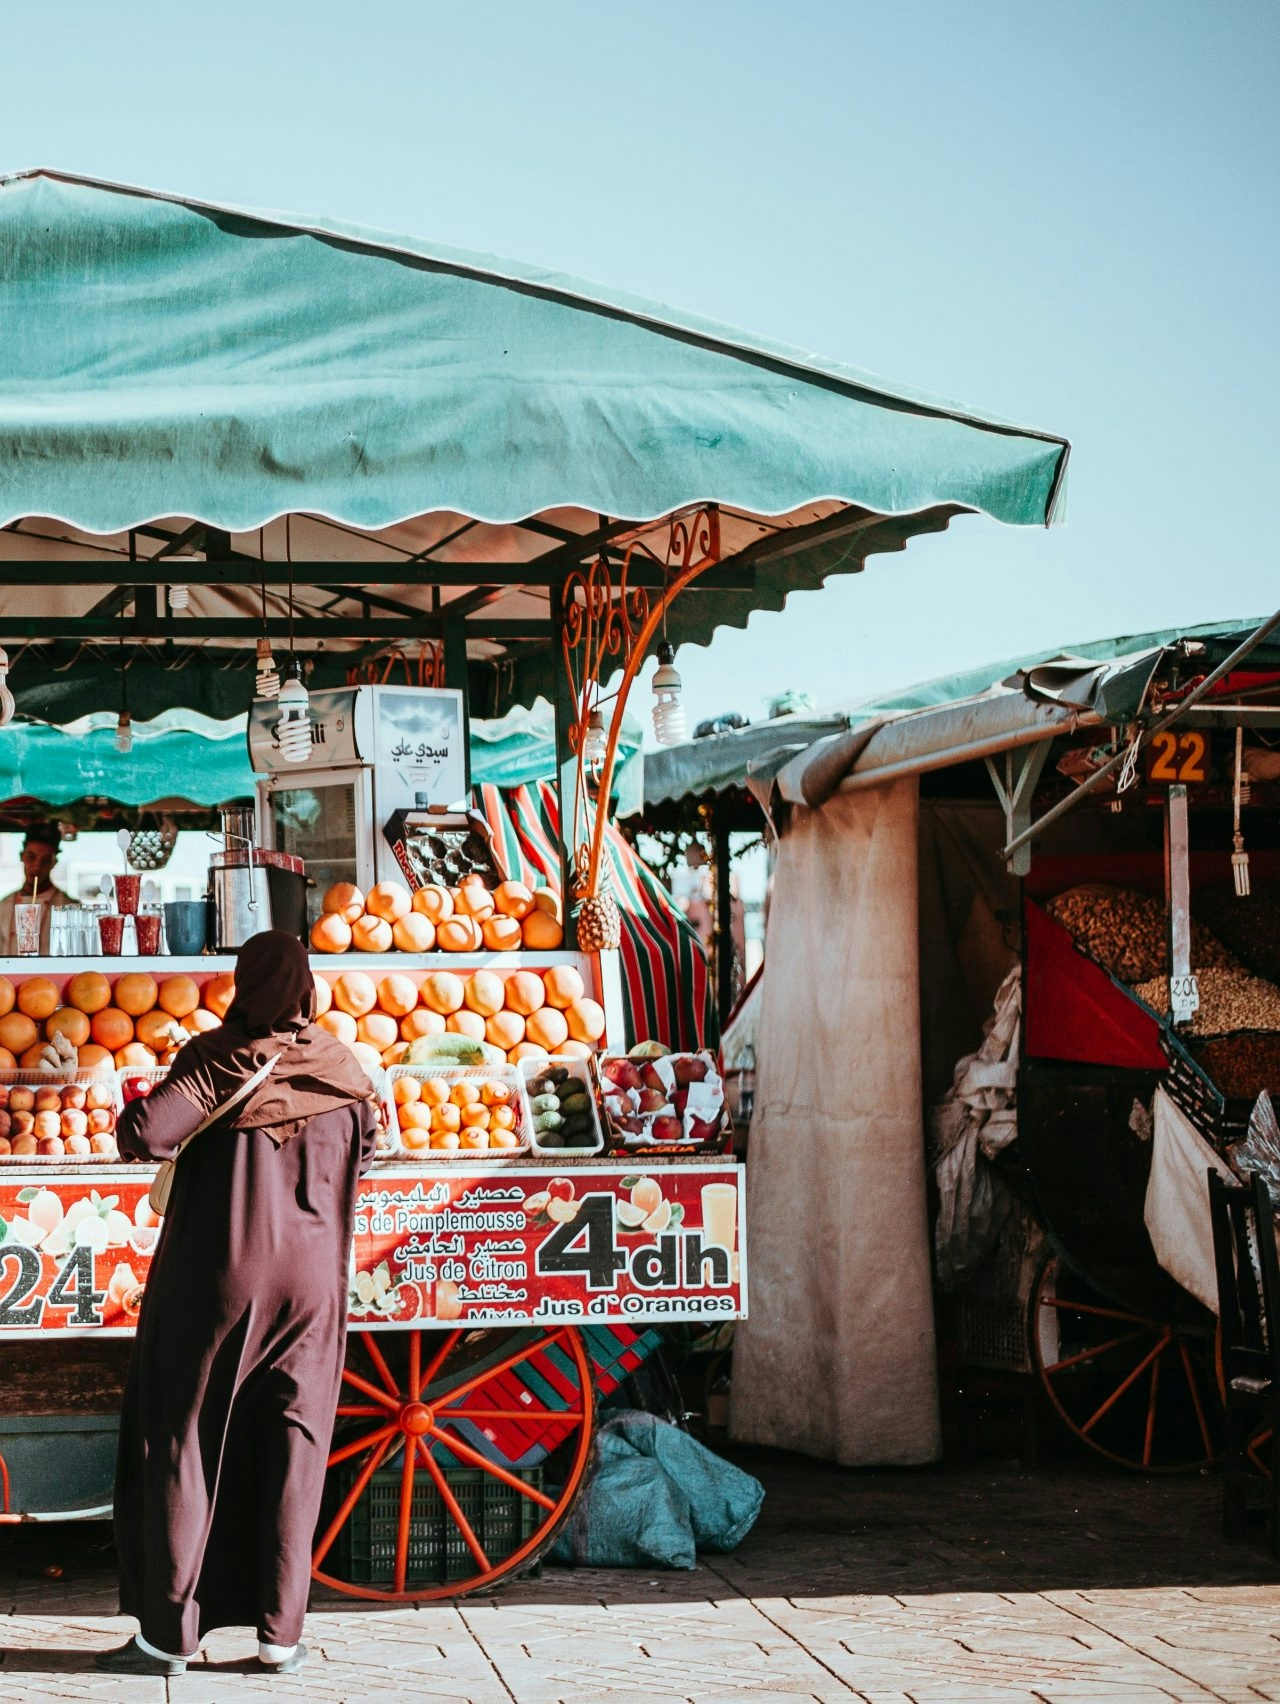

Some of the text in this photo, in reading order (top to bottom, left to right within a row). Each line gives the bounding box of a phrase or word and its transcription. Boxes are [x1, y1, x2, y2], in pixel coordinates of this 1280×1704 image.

[391, 737, 448, 764] سيدي علي
[1151, 731, 1204, 780] 22
[1173, 977, 1198, 997] 200
[456, 1186, 524, 1207] عصير
[372, 1211, 392, 1232] de
[398, 1210, 524, 1234] Pomplemousse
[395, 1236, 524, 1261] عصير الحامض
[538, 1195, 729, 1288] 4dh
[404, 1259, 526, 1281] Jus de Citron
[457, 1285, 526, 1301] مختلط
[536, 1299, 581, 1316] Jus
